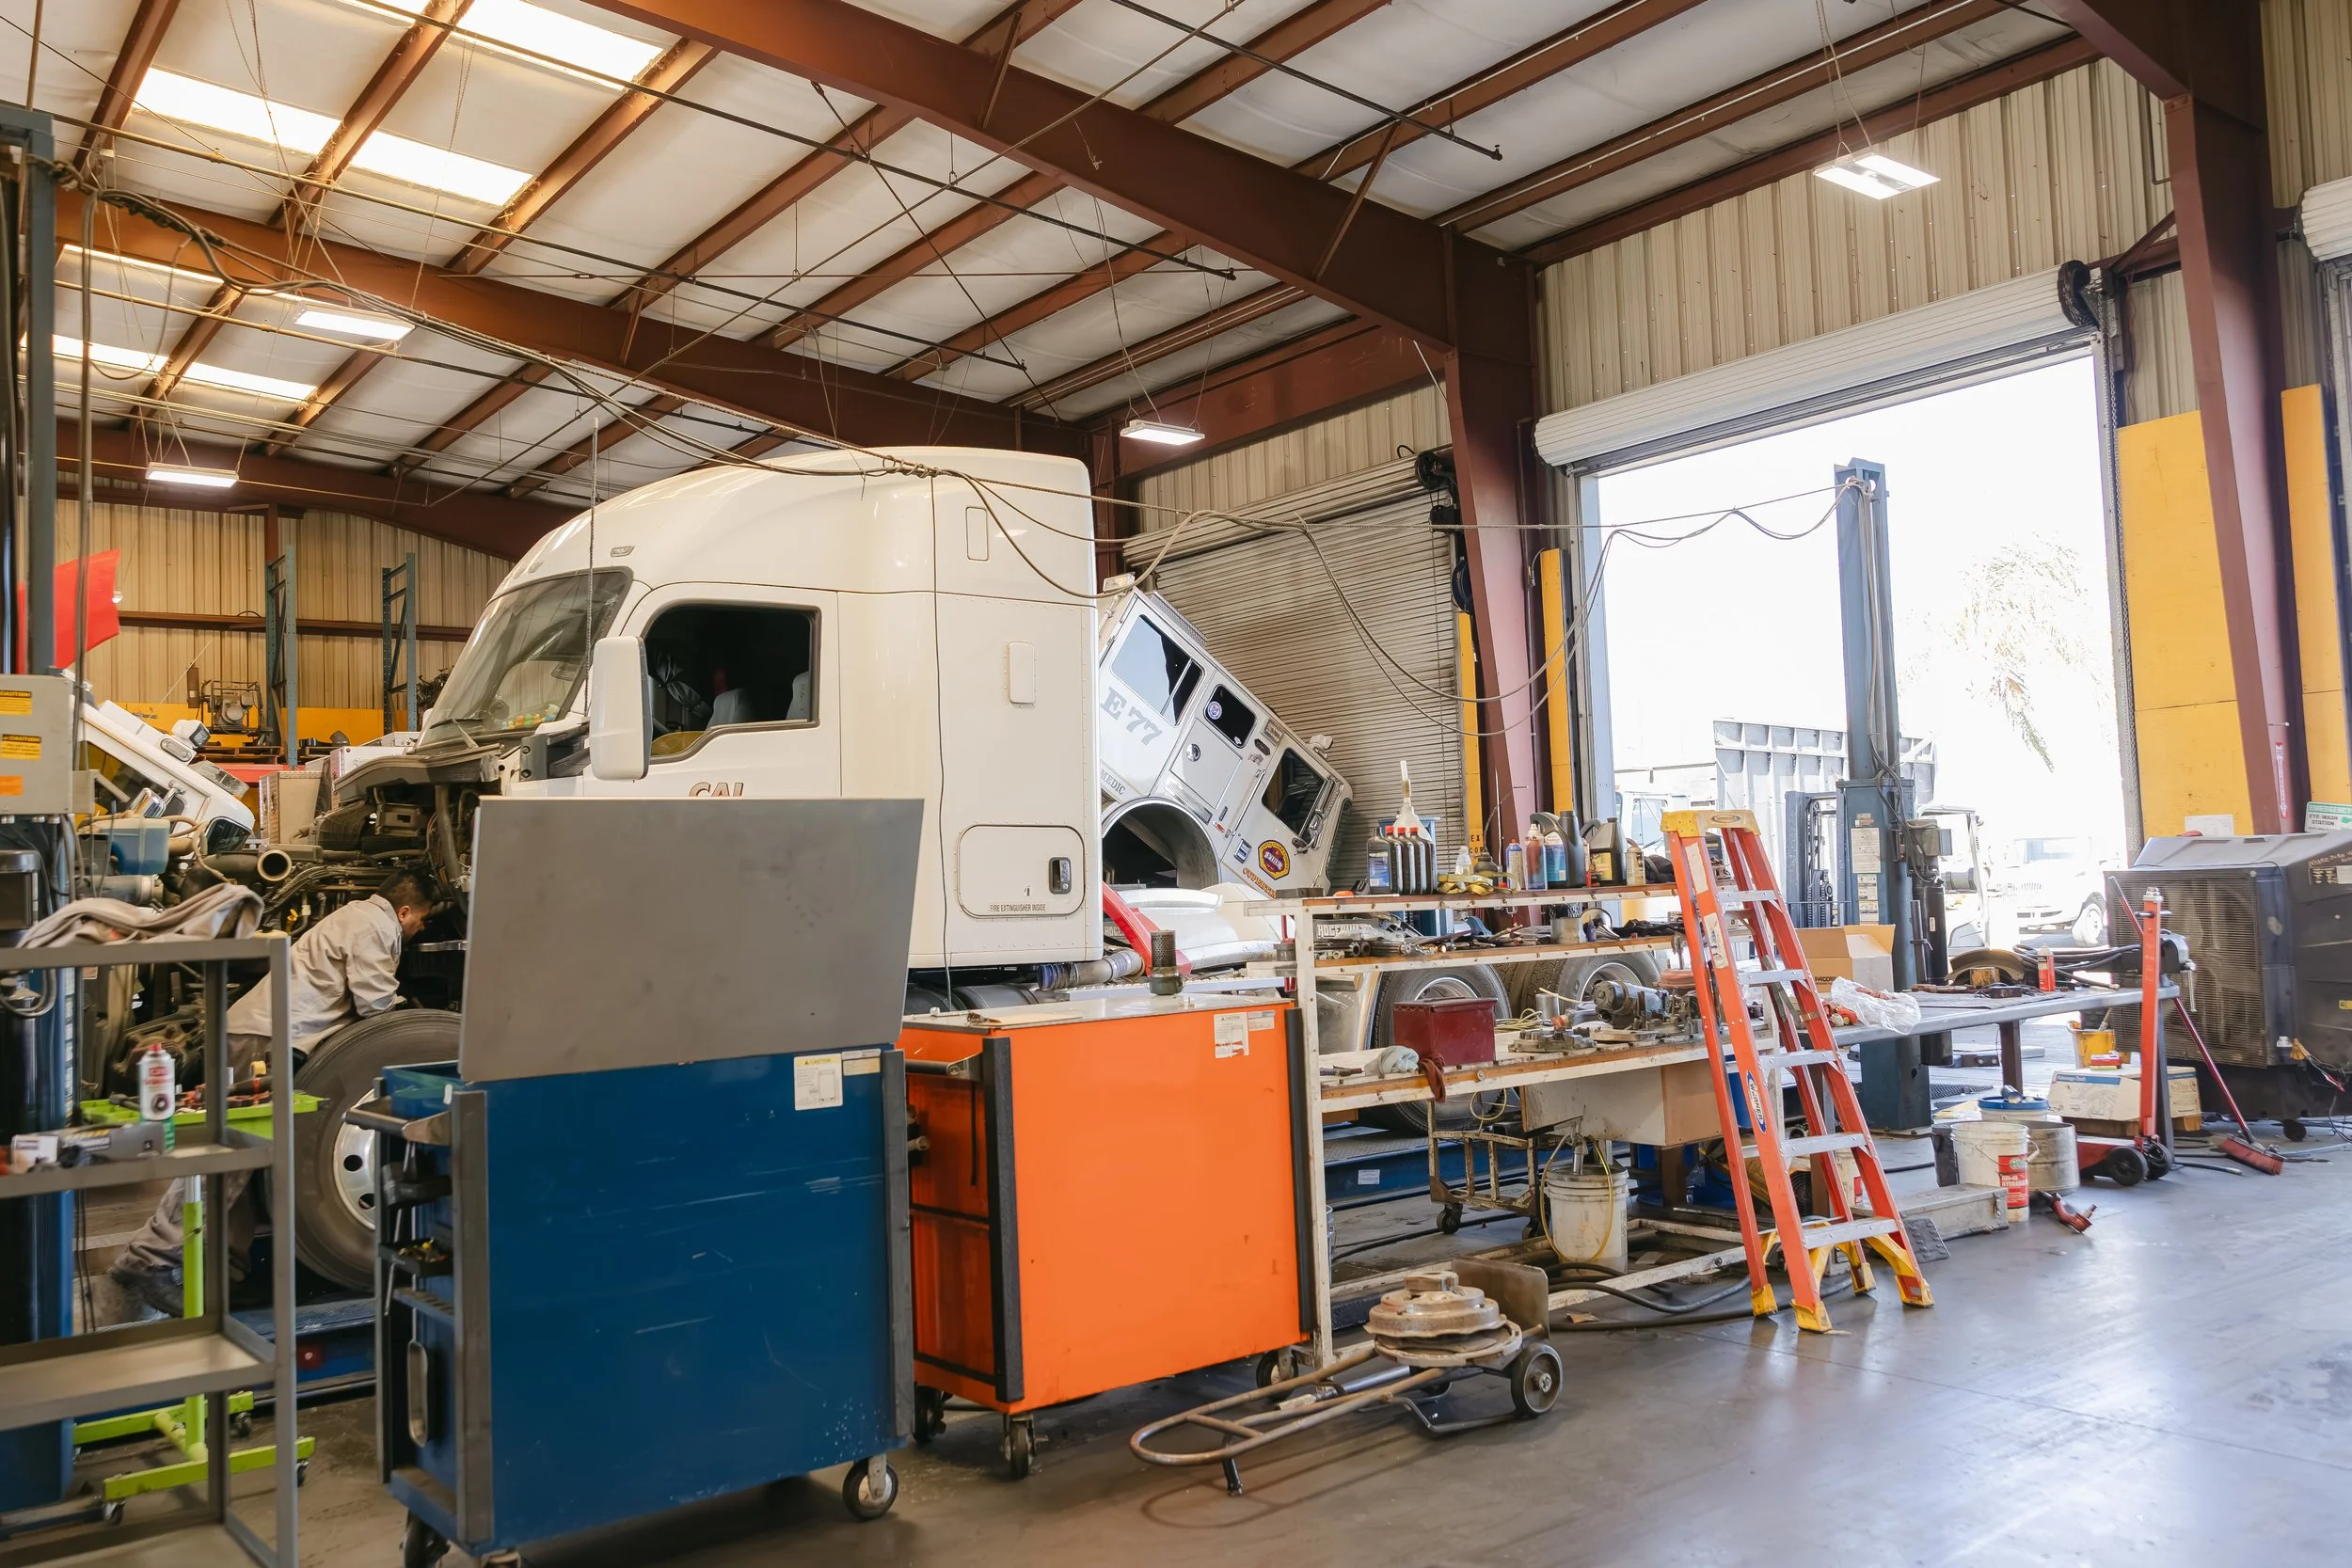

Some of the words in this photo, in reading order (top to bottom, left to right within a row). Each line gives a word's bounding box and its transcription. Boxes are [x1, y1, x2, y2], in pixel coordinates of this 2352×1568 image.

[1100, 687, 1127, 721] E
[1125, 706, 1163, 746] 77
[1100, 768, 1126, 796] MEDIC
[991, 904, 1000, 912] FIRE
[1001, 904, 1031, 912] EXTINGUISHER
[1032, 903, 1046, 911] INSIDE
